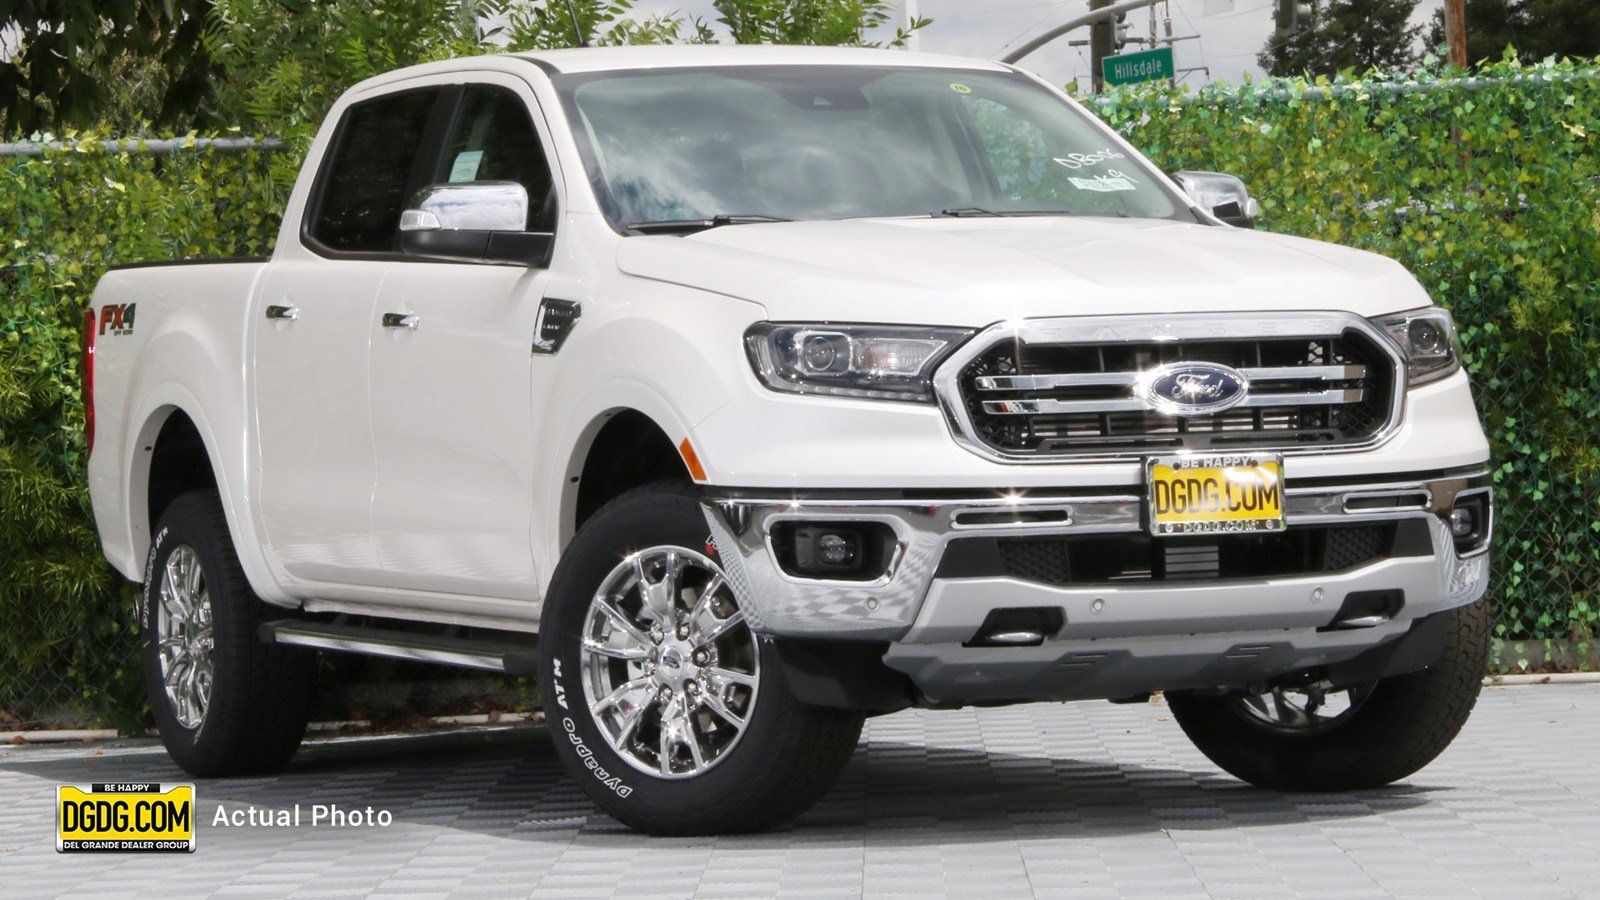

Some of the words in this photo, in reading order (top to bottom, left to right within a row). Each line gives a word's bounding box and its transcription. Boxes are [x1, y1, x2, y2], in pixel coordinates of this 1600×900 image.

[1114, 58, 1162, 80] Hillsdale
[99, 302, 136, 335] FX4
[1171, 374, 1224, 399] Frd
[1181, 459, 1200, 469] BE
[1203, 456, 1249, 468] HAPPY
[1154, 478, 1279, 515] DGDG.COM
[562, 717, 634, 799] Dynapro
